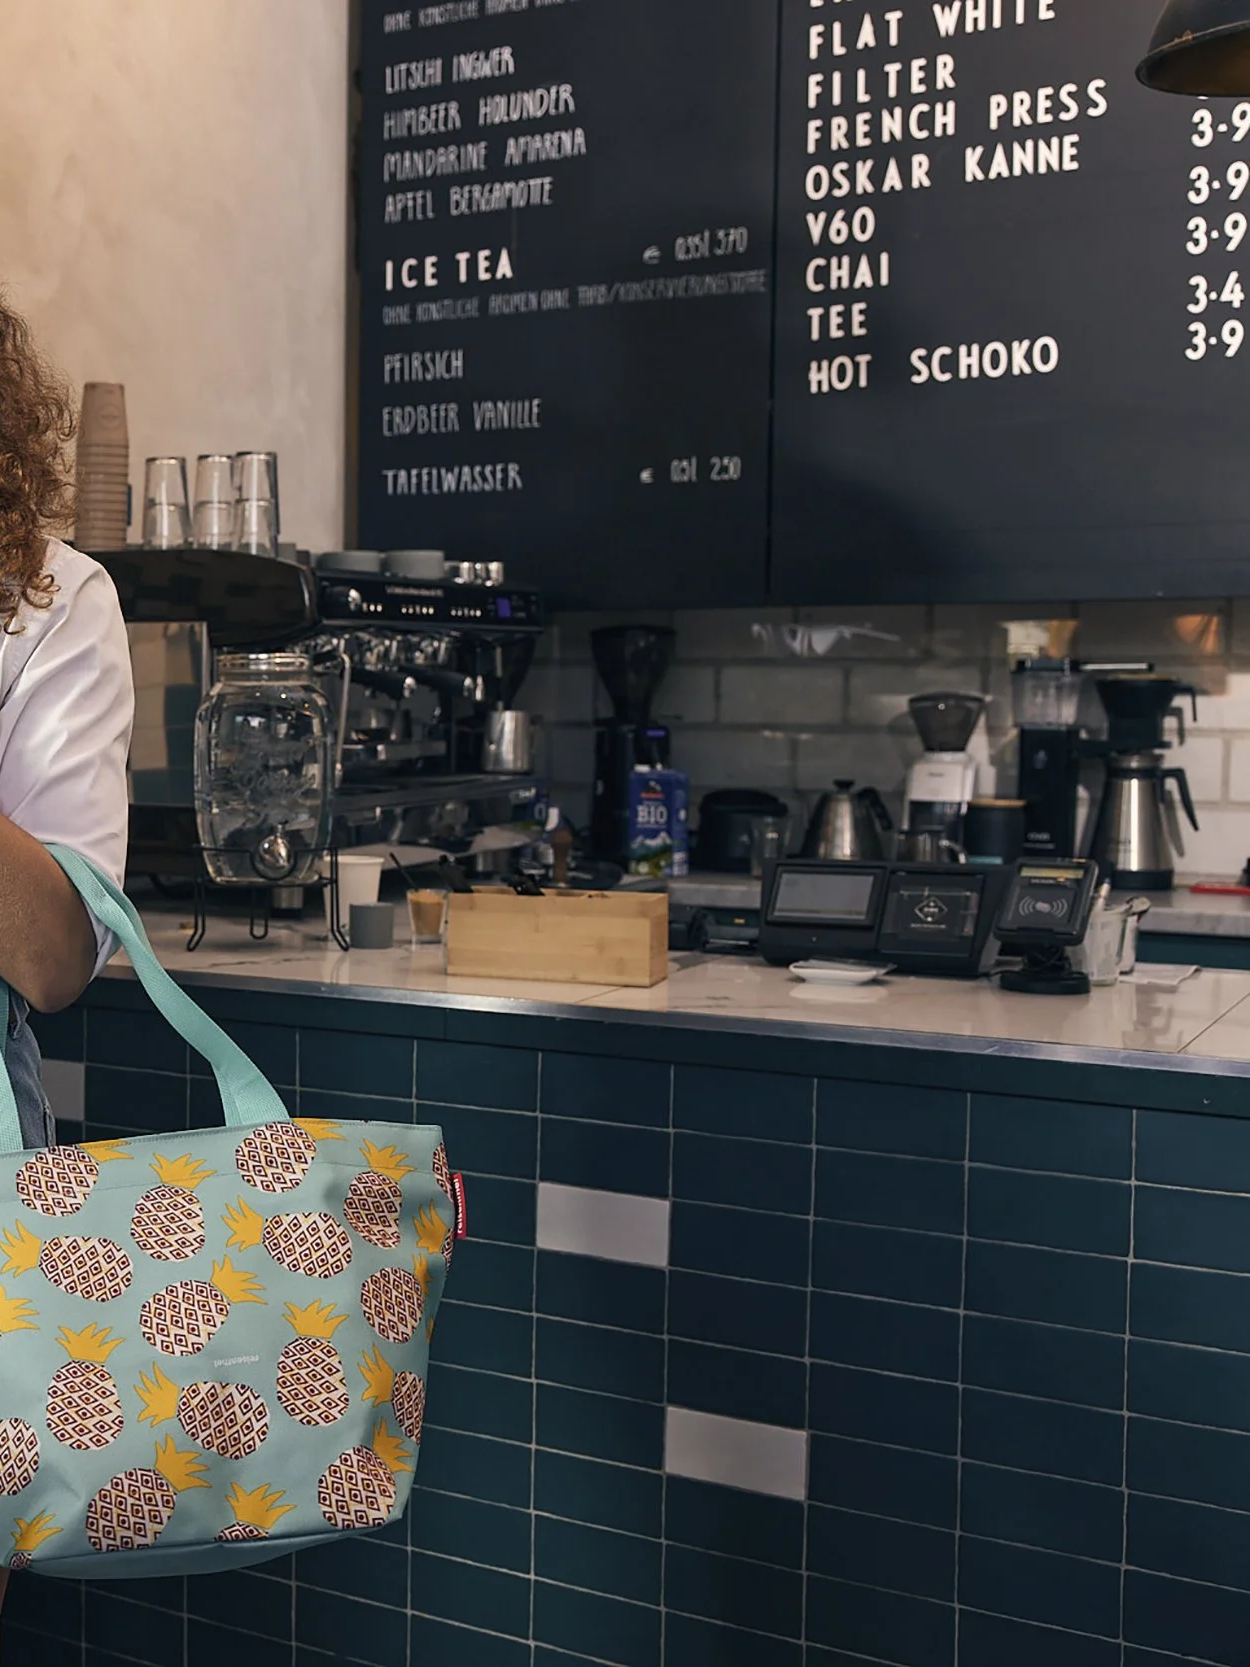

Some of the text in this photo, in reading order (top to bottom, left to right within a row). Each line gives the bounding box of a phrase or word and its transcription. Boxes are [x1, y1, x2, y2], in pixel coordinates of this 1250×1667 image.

[810, 0, 1056, 59] FLAT WHITE
[807, 54, 956, 109] FILTER
[384, 84, 575, 139] HIMBEER HOLUNDER
[806, 79, 1107, 154] FRENCH PRESS
[384, 128, 586, 181] MANDARINE AMARENA
[805, 134, 1079, 201] OSKAR KANNE
[806, 206, 875, 244] V60
[386, 248, 513, 290] ICE TEA
[806, 252, 888, 292] CHAI
[807, 302, 867, 340] TEE
[384, 349, 463, 383] PFIRSICH
[809, 336, 1058, 393] HOT SCHOKO
[383, 398, 540, 436] ERDBEER VANILLE
[383, 463, 522, 494] TAFELWASSER
